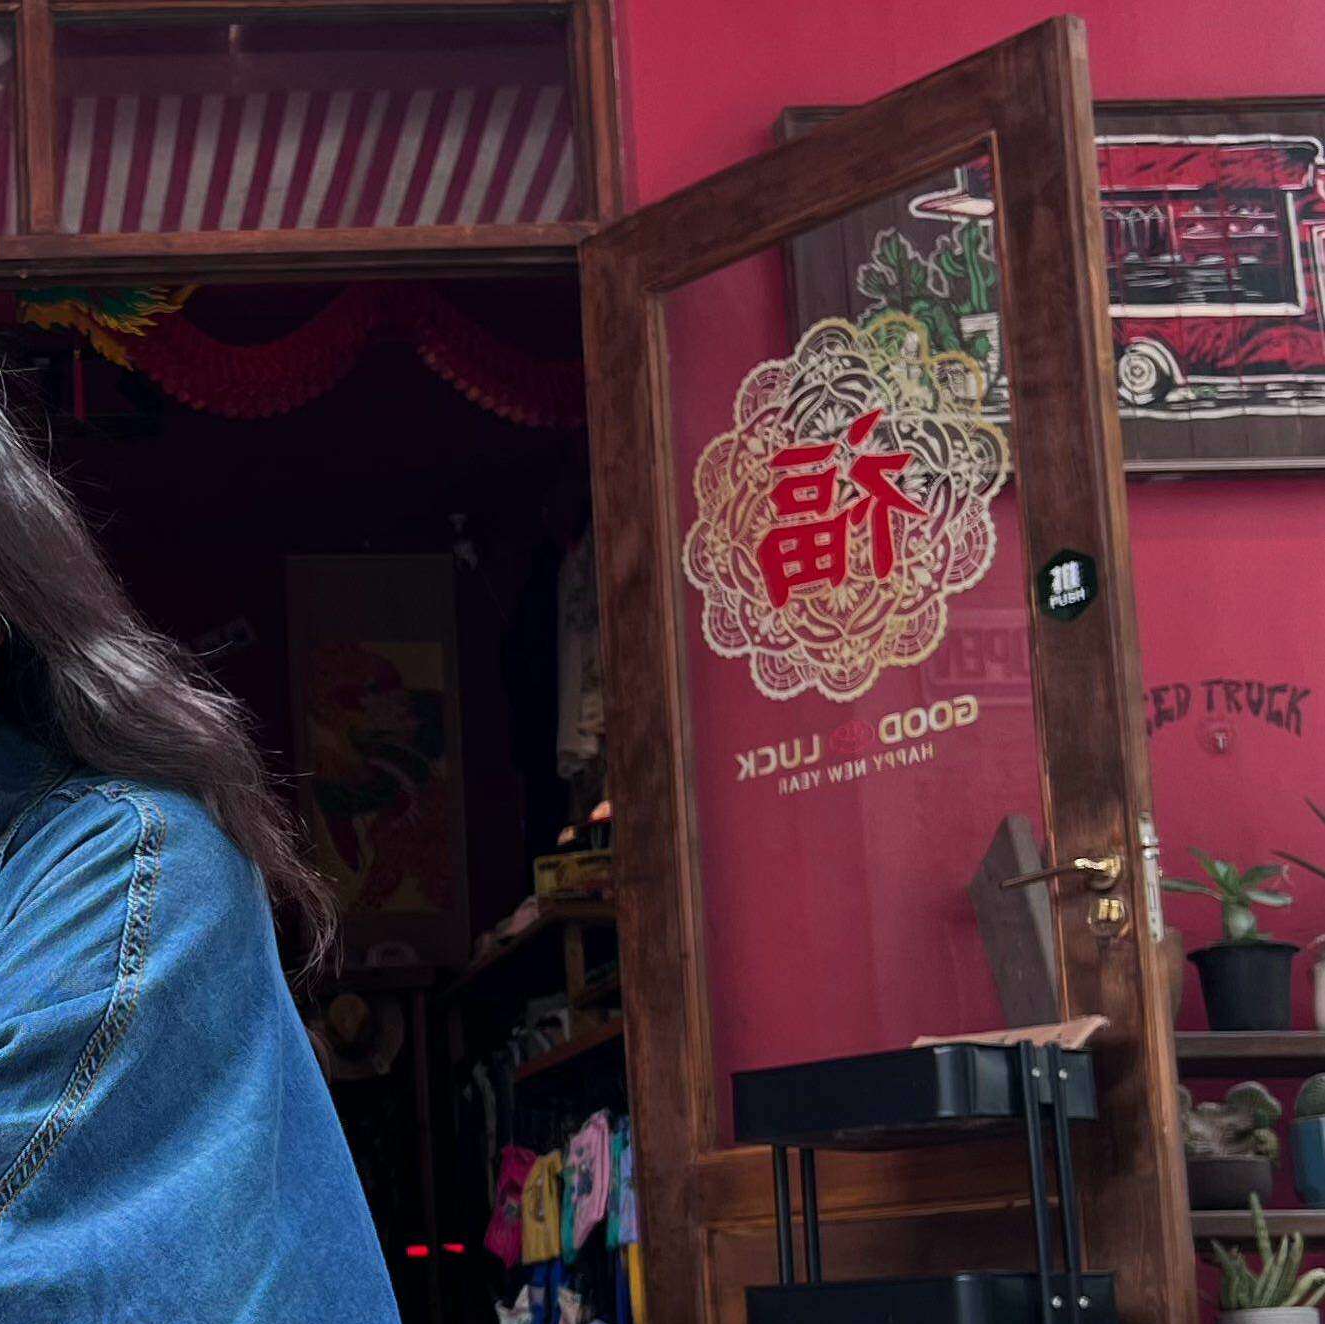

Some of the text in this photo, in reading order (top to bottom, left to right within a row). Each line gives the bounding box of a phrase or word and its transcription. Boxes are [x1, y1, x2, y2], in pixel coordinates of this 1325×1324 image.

[1049, 586, 1086, 609] PUSH
[1144, 676, 1311, 738] ED TRUCK
